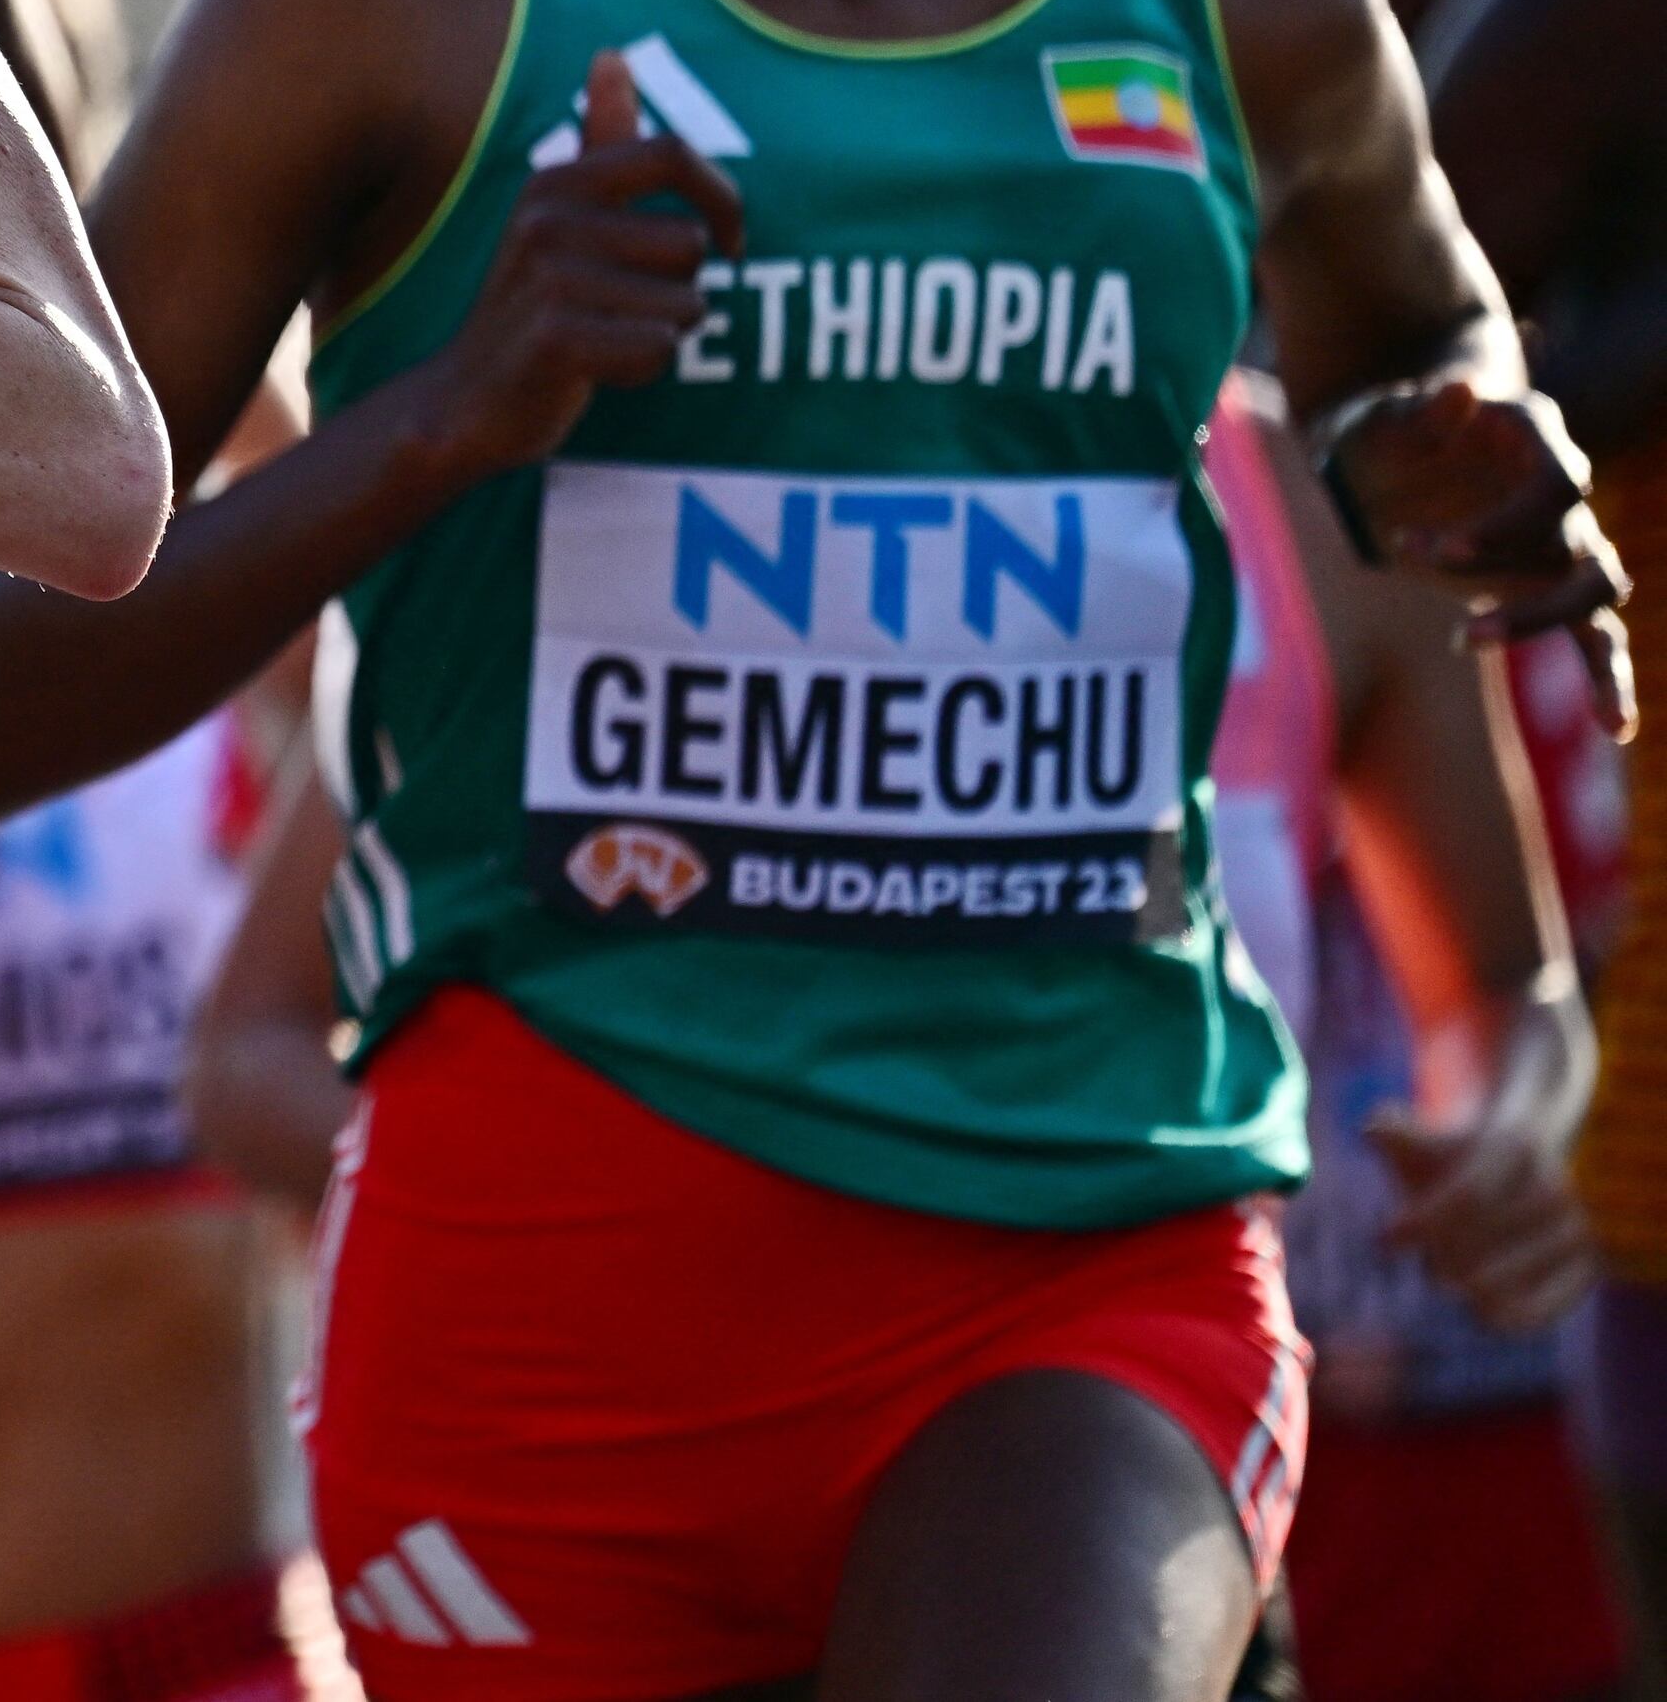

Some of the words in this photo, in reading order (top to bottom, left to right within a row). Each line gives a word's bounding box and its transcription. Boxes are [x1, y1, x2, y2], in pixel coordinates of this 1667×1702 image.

[676, 255, 1136, 397] ETHIOPIA
[671, 480, 1087, 644] NTN
[570, 654, 1149, 813] GEMECHU
[729, 858, 1063, 916] BUDAPEST
